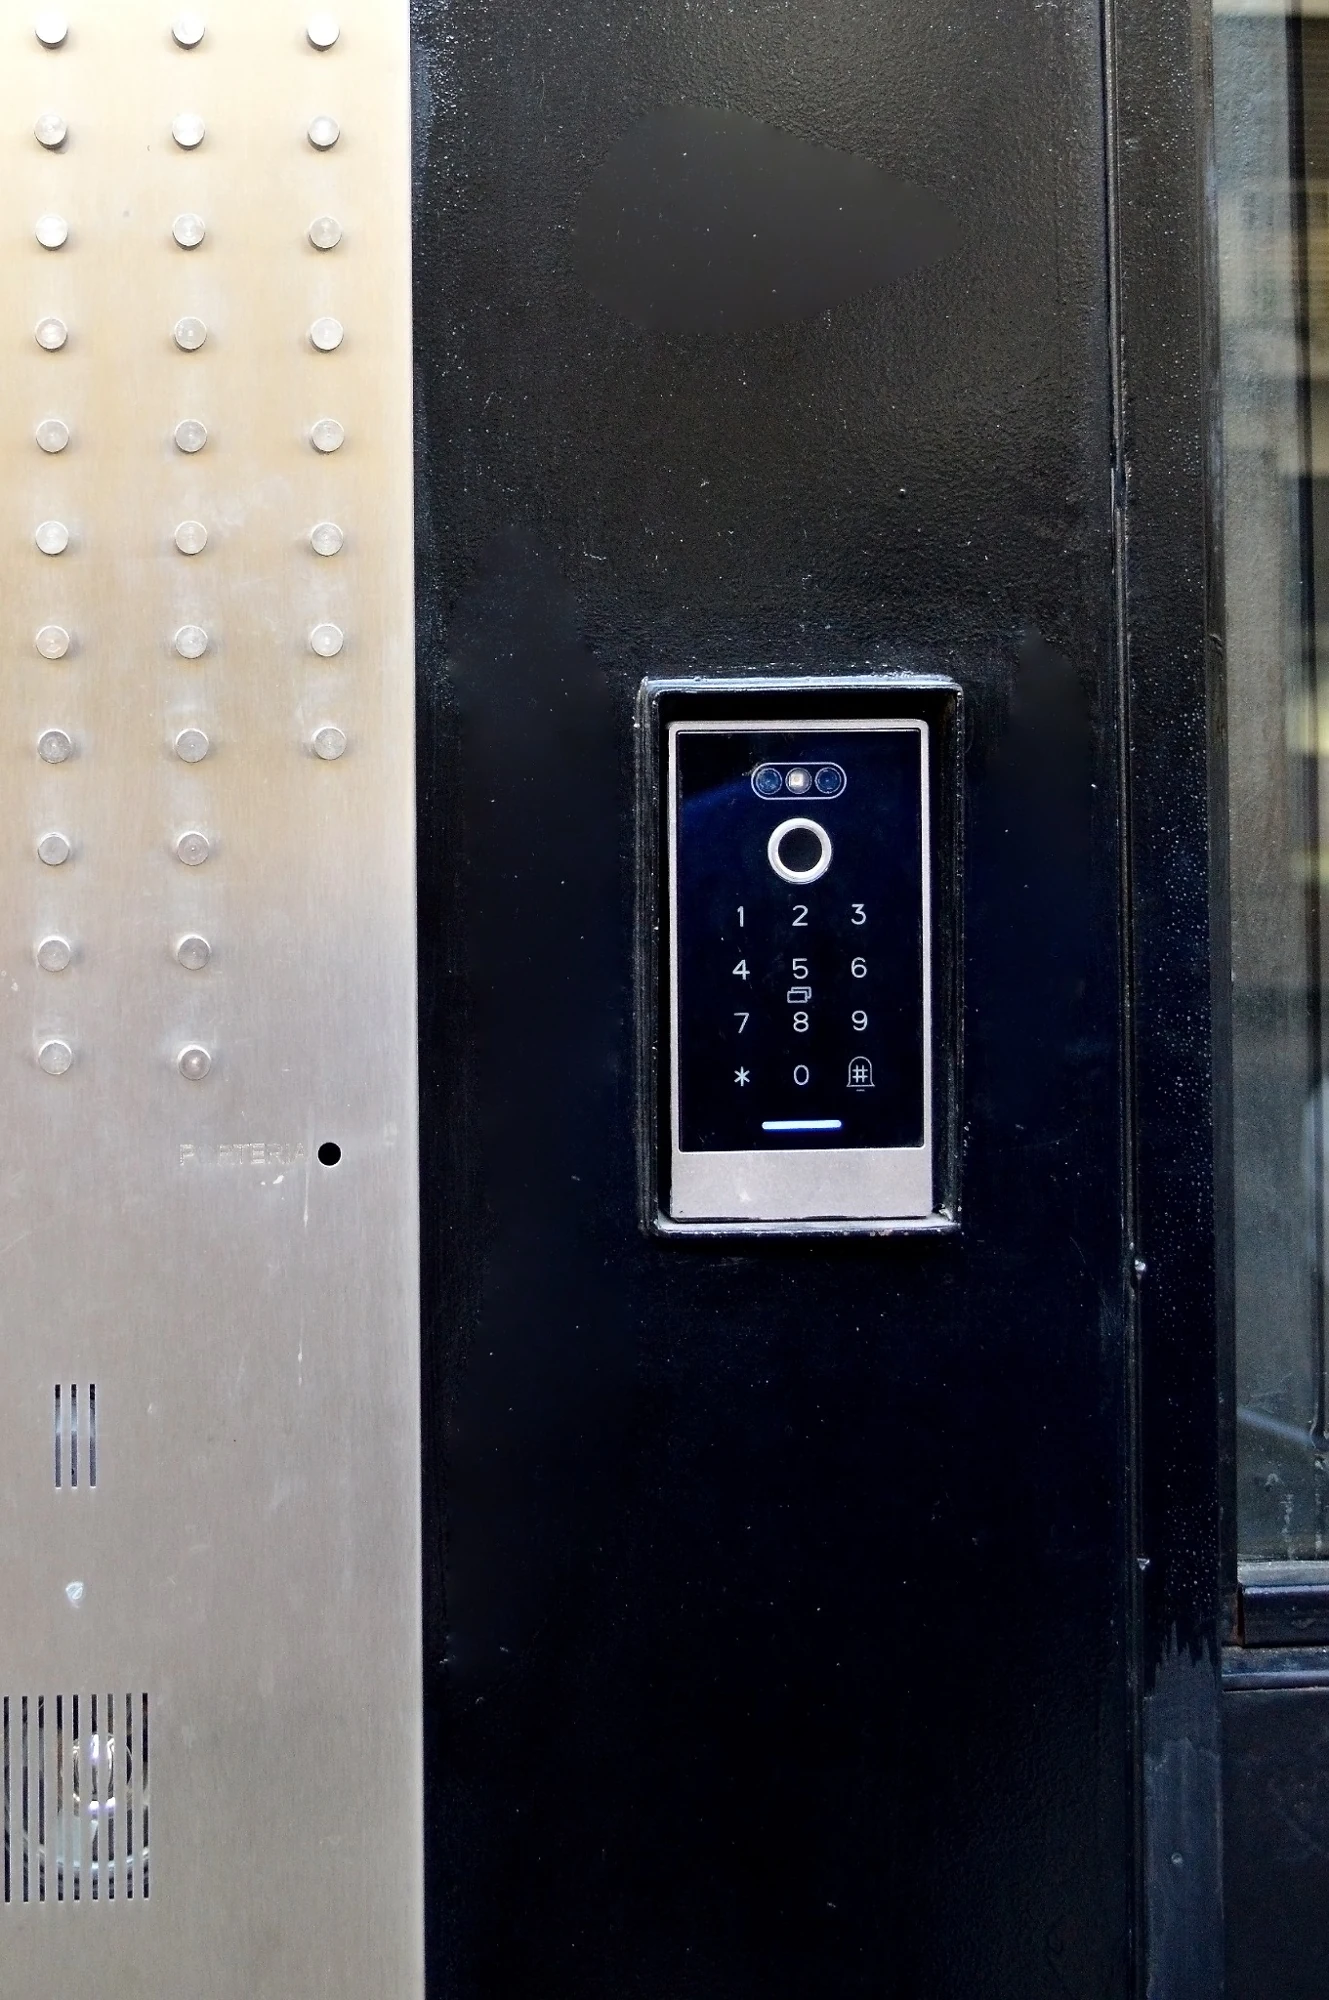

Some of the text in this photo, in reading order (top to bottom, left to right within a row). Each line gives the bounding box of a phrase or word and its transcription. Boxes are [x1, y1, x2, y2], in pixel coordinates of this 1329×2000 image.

[737, 903, 866, 928] 1 2 3
[732, 956, 867, 981] 4 5 6
[734, 1010, 868, 1034] 7 8 9
[793, 1064, 809, 1086] 0
[179, 1142, 305, 1165] PRTERIA
